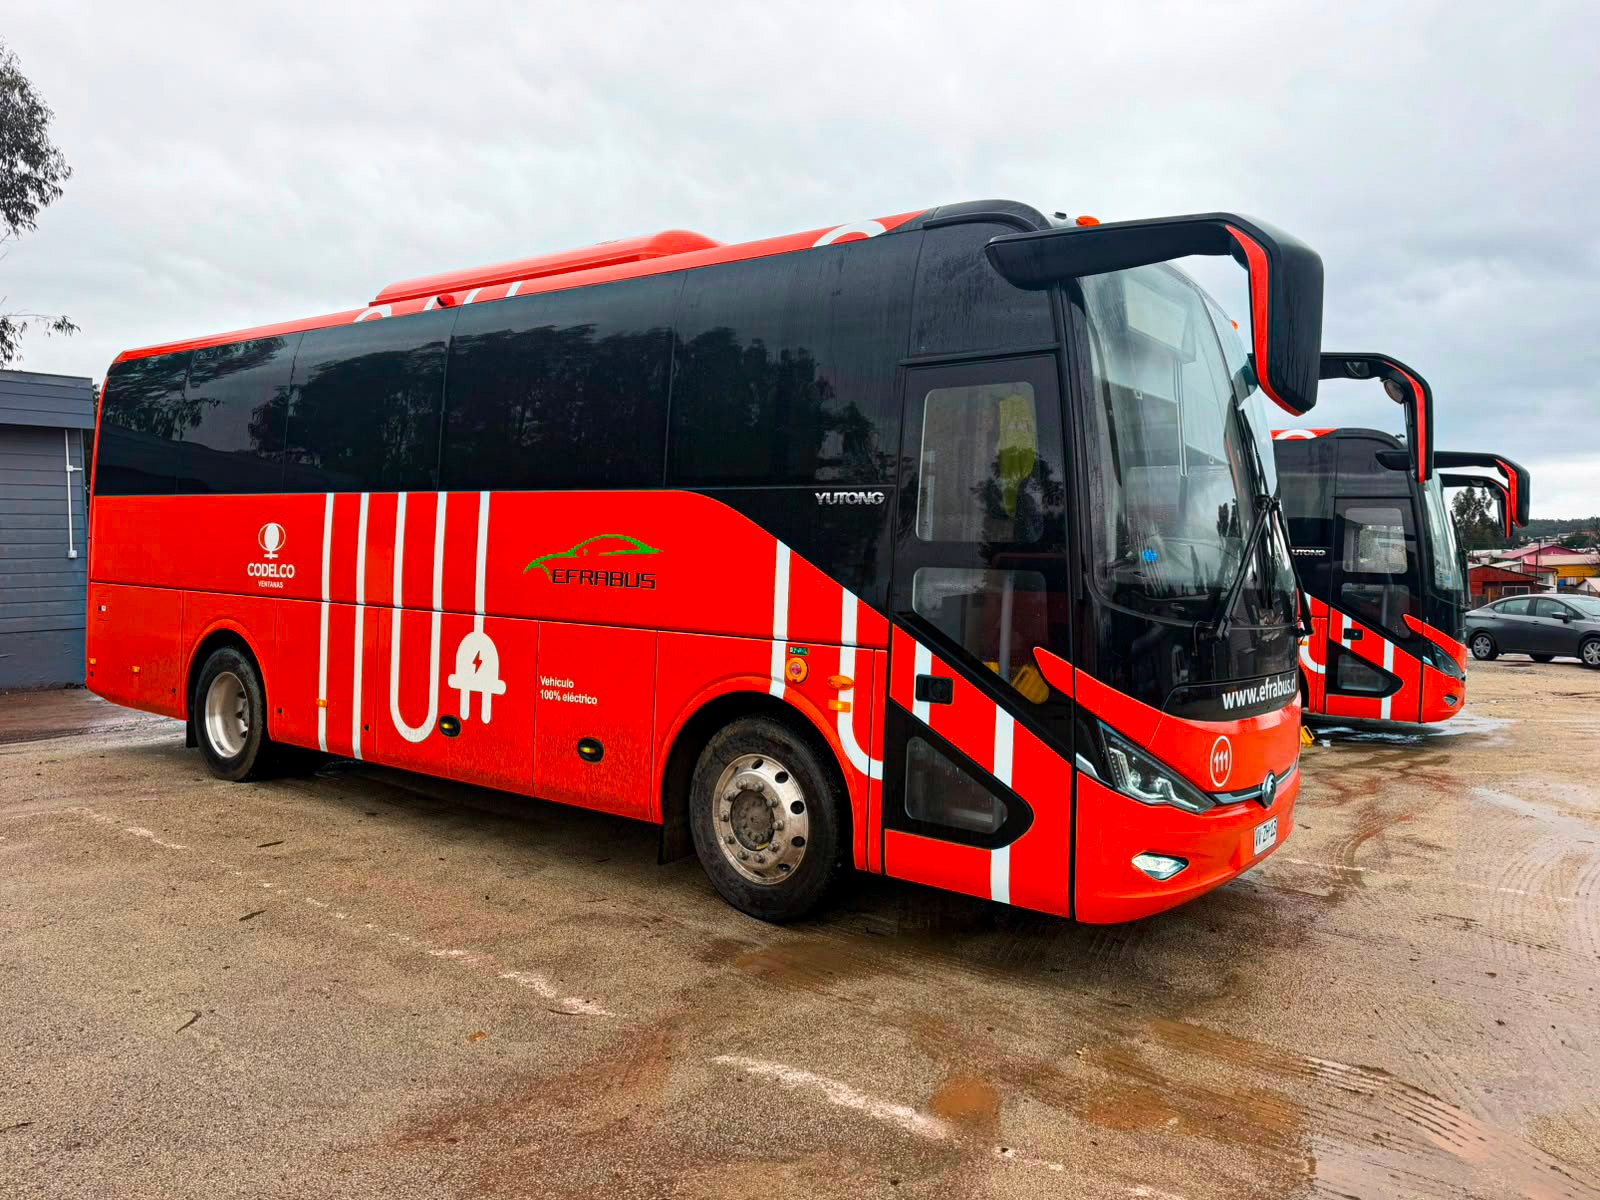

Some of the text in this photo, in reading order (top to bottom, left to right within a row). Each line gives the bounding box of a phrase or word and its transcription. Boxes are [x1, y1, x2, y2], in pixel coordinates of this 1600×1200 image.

[814, 491, 885, 505] YUTONG
[247, 562, 295, 578] CODELCO
[258, 580, 284, 589] VENTANAS
[552, 568, 657, 590] EFRABUS
[540, 689, 598, 705] 100% eléctrico
[1222, 673, 1296, 710] www.efrabus.cl
[1213, 749, 1229, 773] 111
